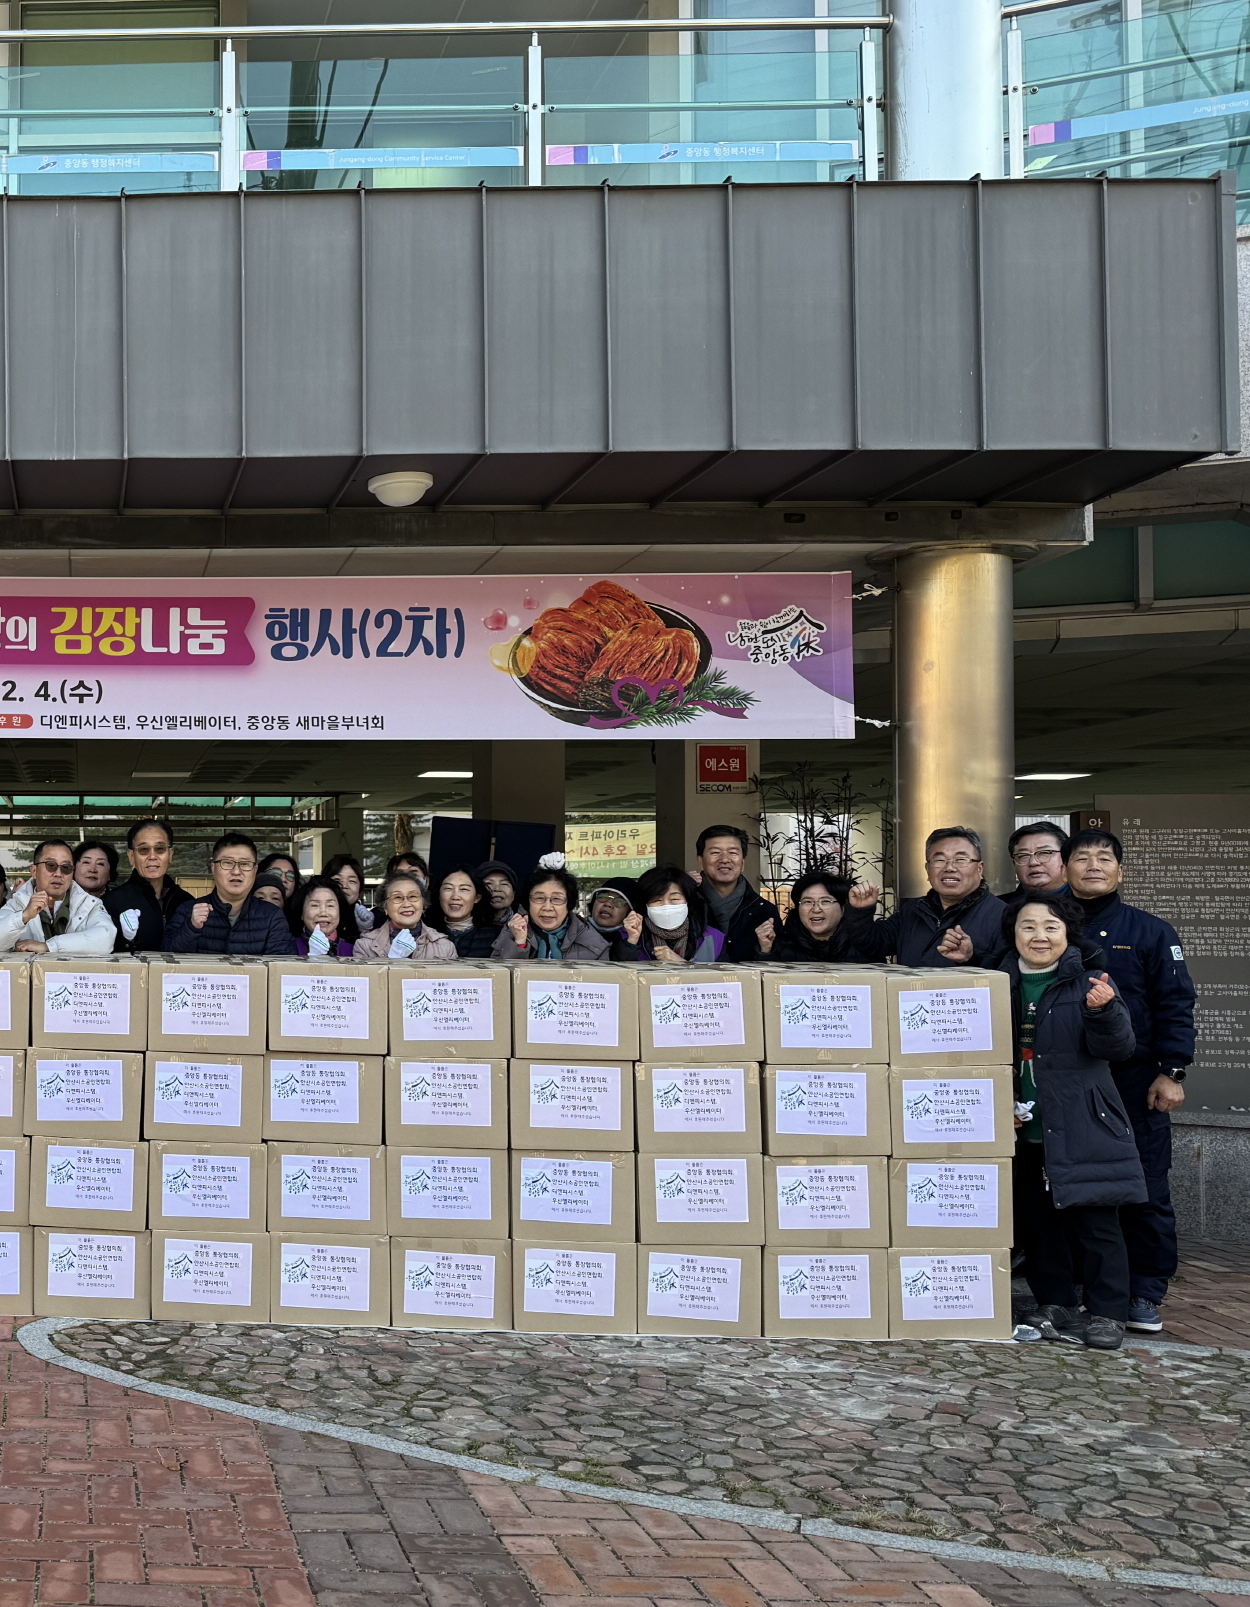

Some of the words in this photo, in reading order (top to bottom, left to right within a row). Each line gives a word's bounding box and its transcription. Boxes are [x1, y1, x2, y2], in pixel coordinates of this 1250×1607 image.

[686, 147, 710, 157] 중앙동
[64, 158, 89, 168] 중앙동
[50, 606, 229, 657] 김장나눔
[264, 606, 466, 662] 행사(2차)
[761, 634, 782, 649] 도시
[750, 644, 791, 665] 중앙동
[34, 679, 104, 704] 4.(수)
[39, 714, 131, 730] 디엔피시스템,
[135, 715, 242, 731] 우신엘리베이터,
[246, 715, 291, 731] 중앙동
[296, 715, 385, 731] 새마을부녀회
[705, 758, 740, 772] 에스원
[699, 784, 732, 792] SECOM
